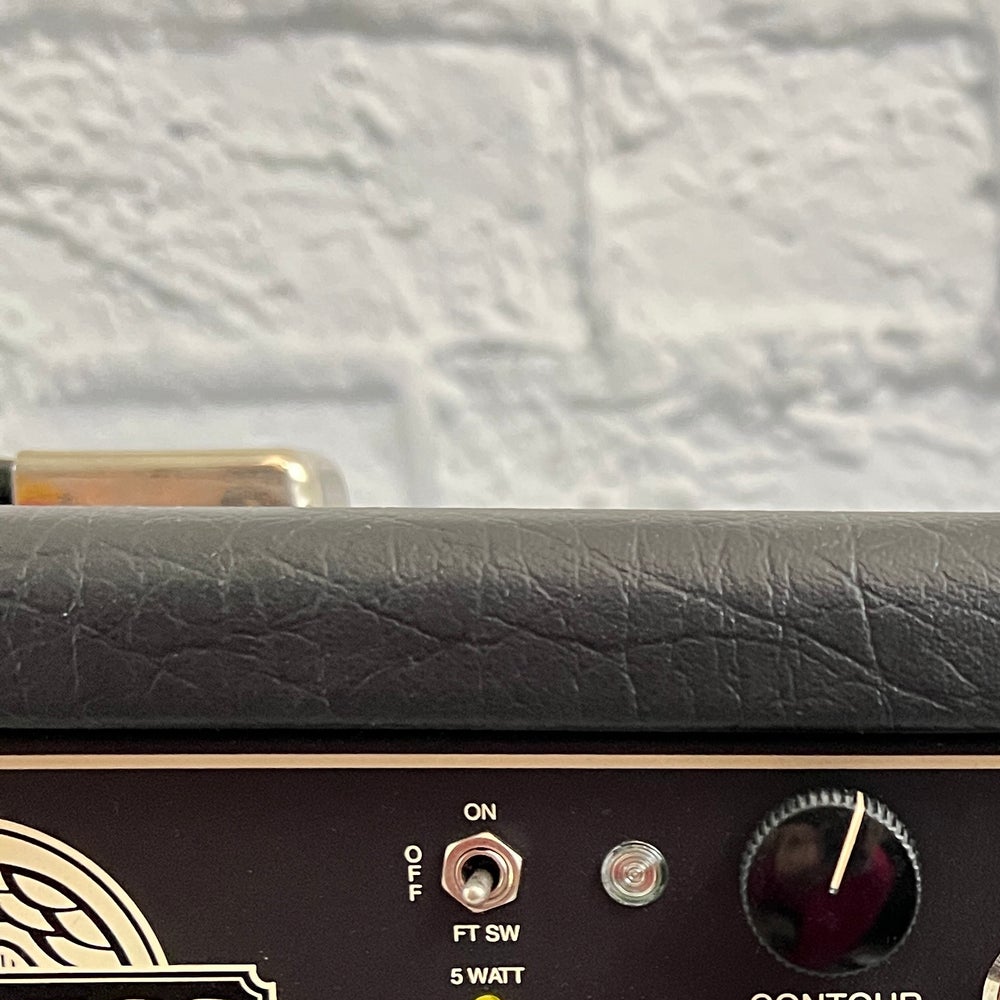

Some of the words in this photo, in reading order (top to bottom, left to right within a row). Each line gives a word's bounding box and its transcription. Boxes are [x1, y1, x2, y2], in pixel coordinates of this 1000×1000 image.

[463, 802, 497, 821] ON
[403, 844, 423, 902] OFF
[452, 924, 481, 943] FT
[485, 924, 521, 943] SW
[450, 967, 464, 986] 5
[466, 966, 526, 985] WATT
